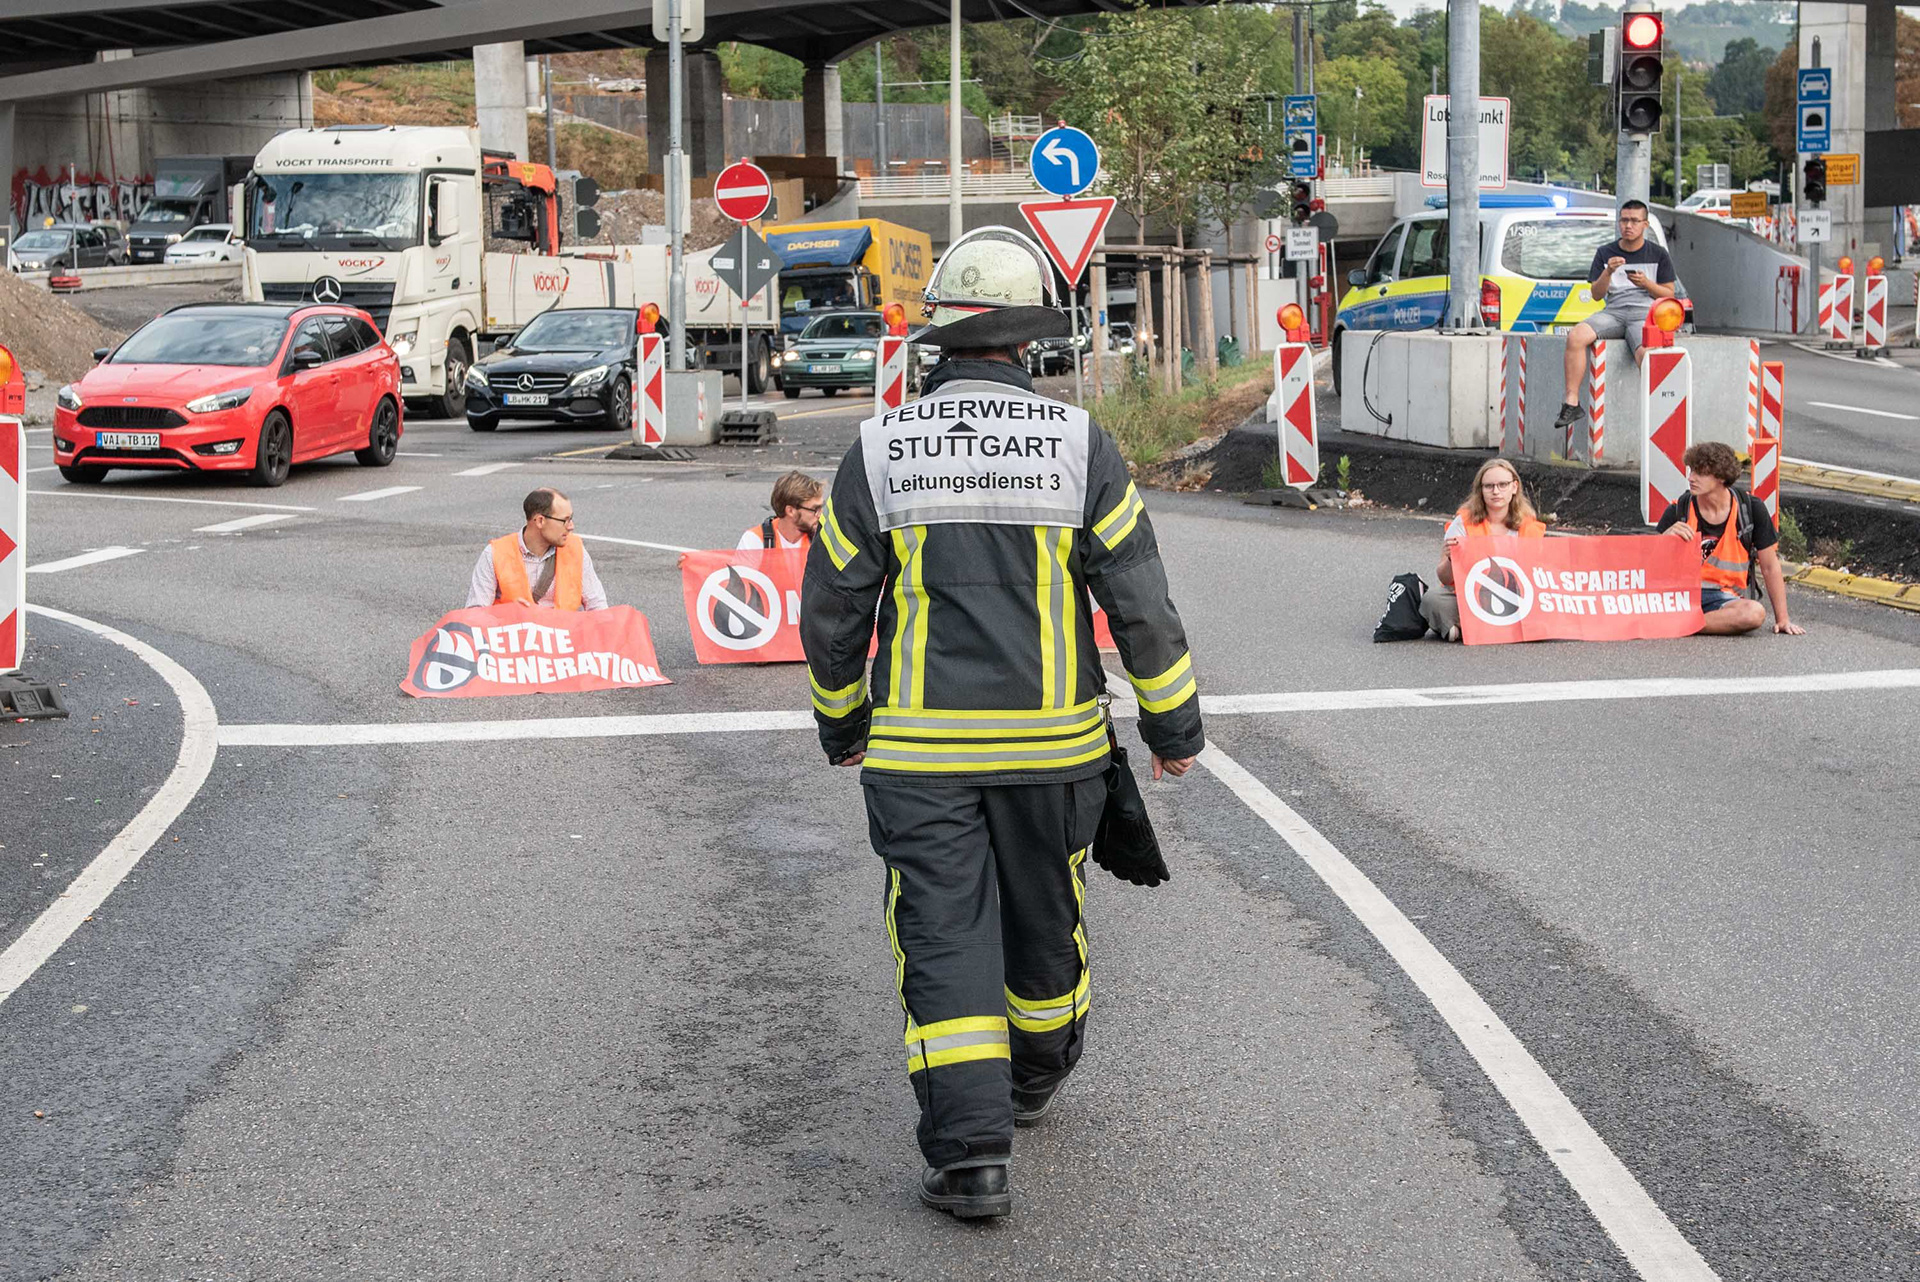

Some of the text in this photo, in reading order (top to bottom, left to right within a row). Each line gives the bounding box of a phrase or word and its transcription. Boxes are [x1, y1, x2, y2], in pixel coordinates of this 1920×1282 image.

[276, 158, 394, 167] VÖCKT TRANSPORTE
[1509, 225, 1538, 237] 1/360
[787, 239, 841, 251] DACHSER
[338, 258, 374, 268] VÖCKT
[1532, 289, 1568, 299] POLIZEI
[1393, 305, 1421, 325] POLIZEI
[533, 395, 547, 404] 217
[882, 400, 1068, 427] FEUERWEHR
[103, 434, 158, 446] VAI TB 112
[888, 435, 1063, 461] STUTTGART
[888, 472, 1061, 494] Leitungsdienst 3
[1532, 566, 1646, 592] ÖL SPAREN
[1538, 591, 1692, 615] STATT BOHREN
[470, 622, 575, 654] LETZTE
[476, 651, 664, 684] GENERATION
